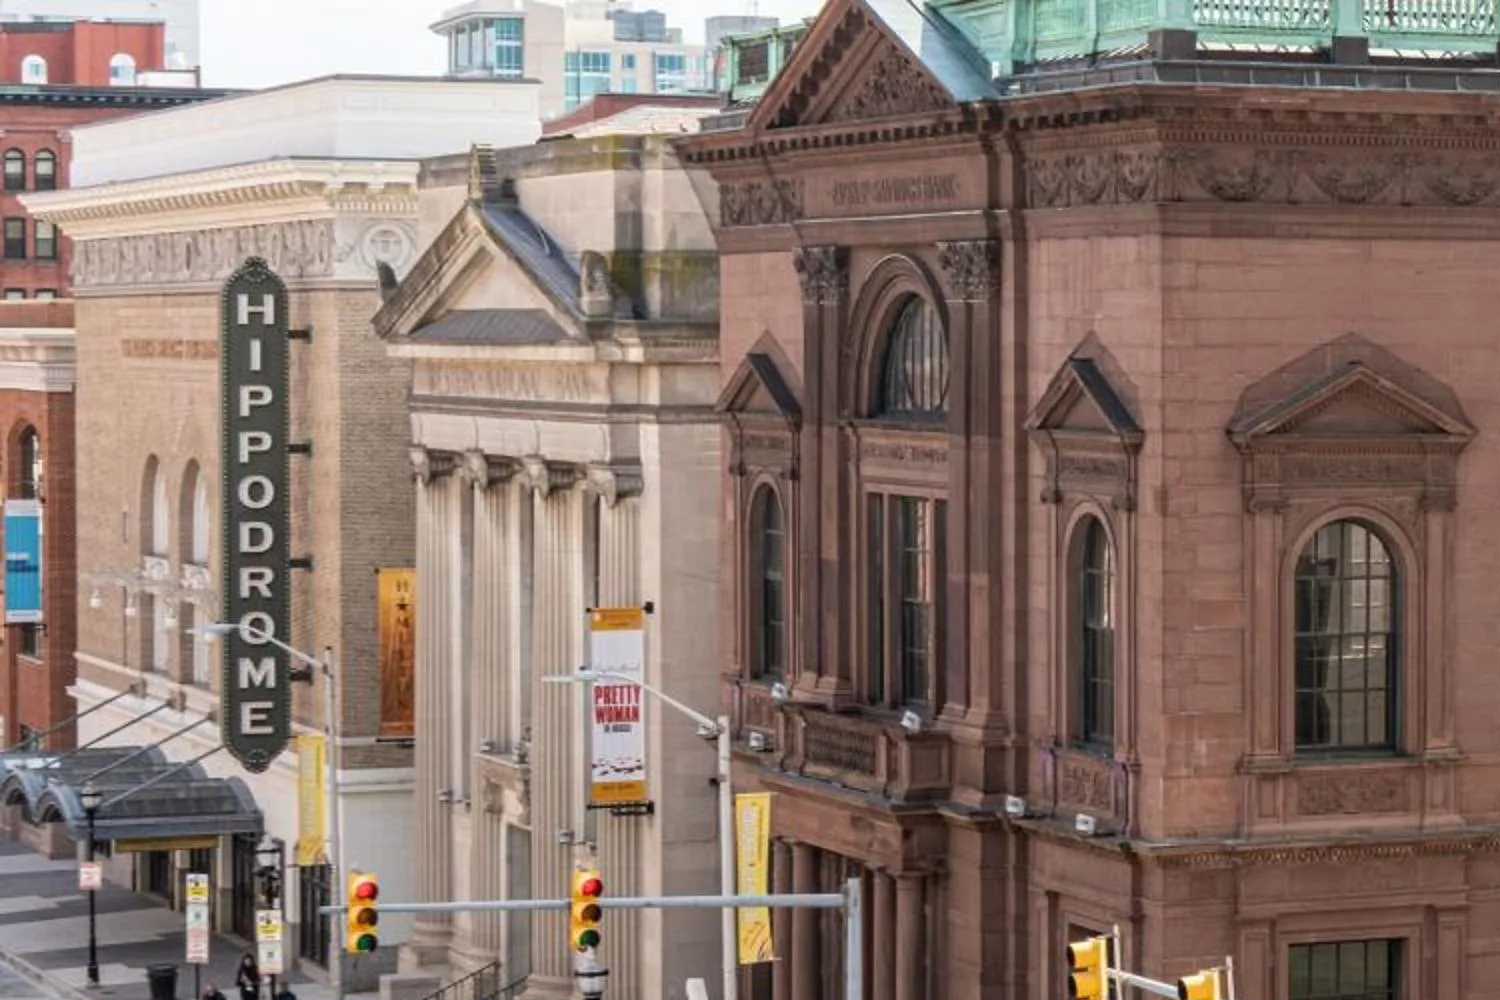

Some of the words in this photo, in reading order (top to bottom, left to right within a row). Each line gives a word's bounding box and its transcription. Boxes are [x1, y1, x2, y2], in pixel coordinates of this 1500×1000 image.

[237, 294, 275, 735] HIPPODROME
[594, 685, 641, 704] PRETTY
[595, 706, 640, 724] WOMAN
